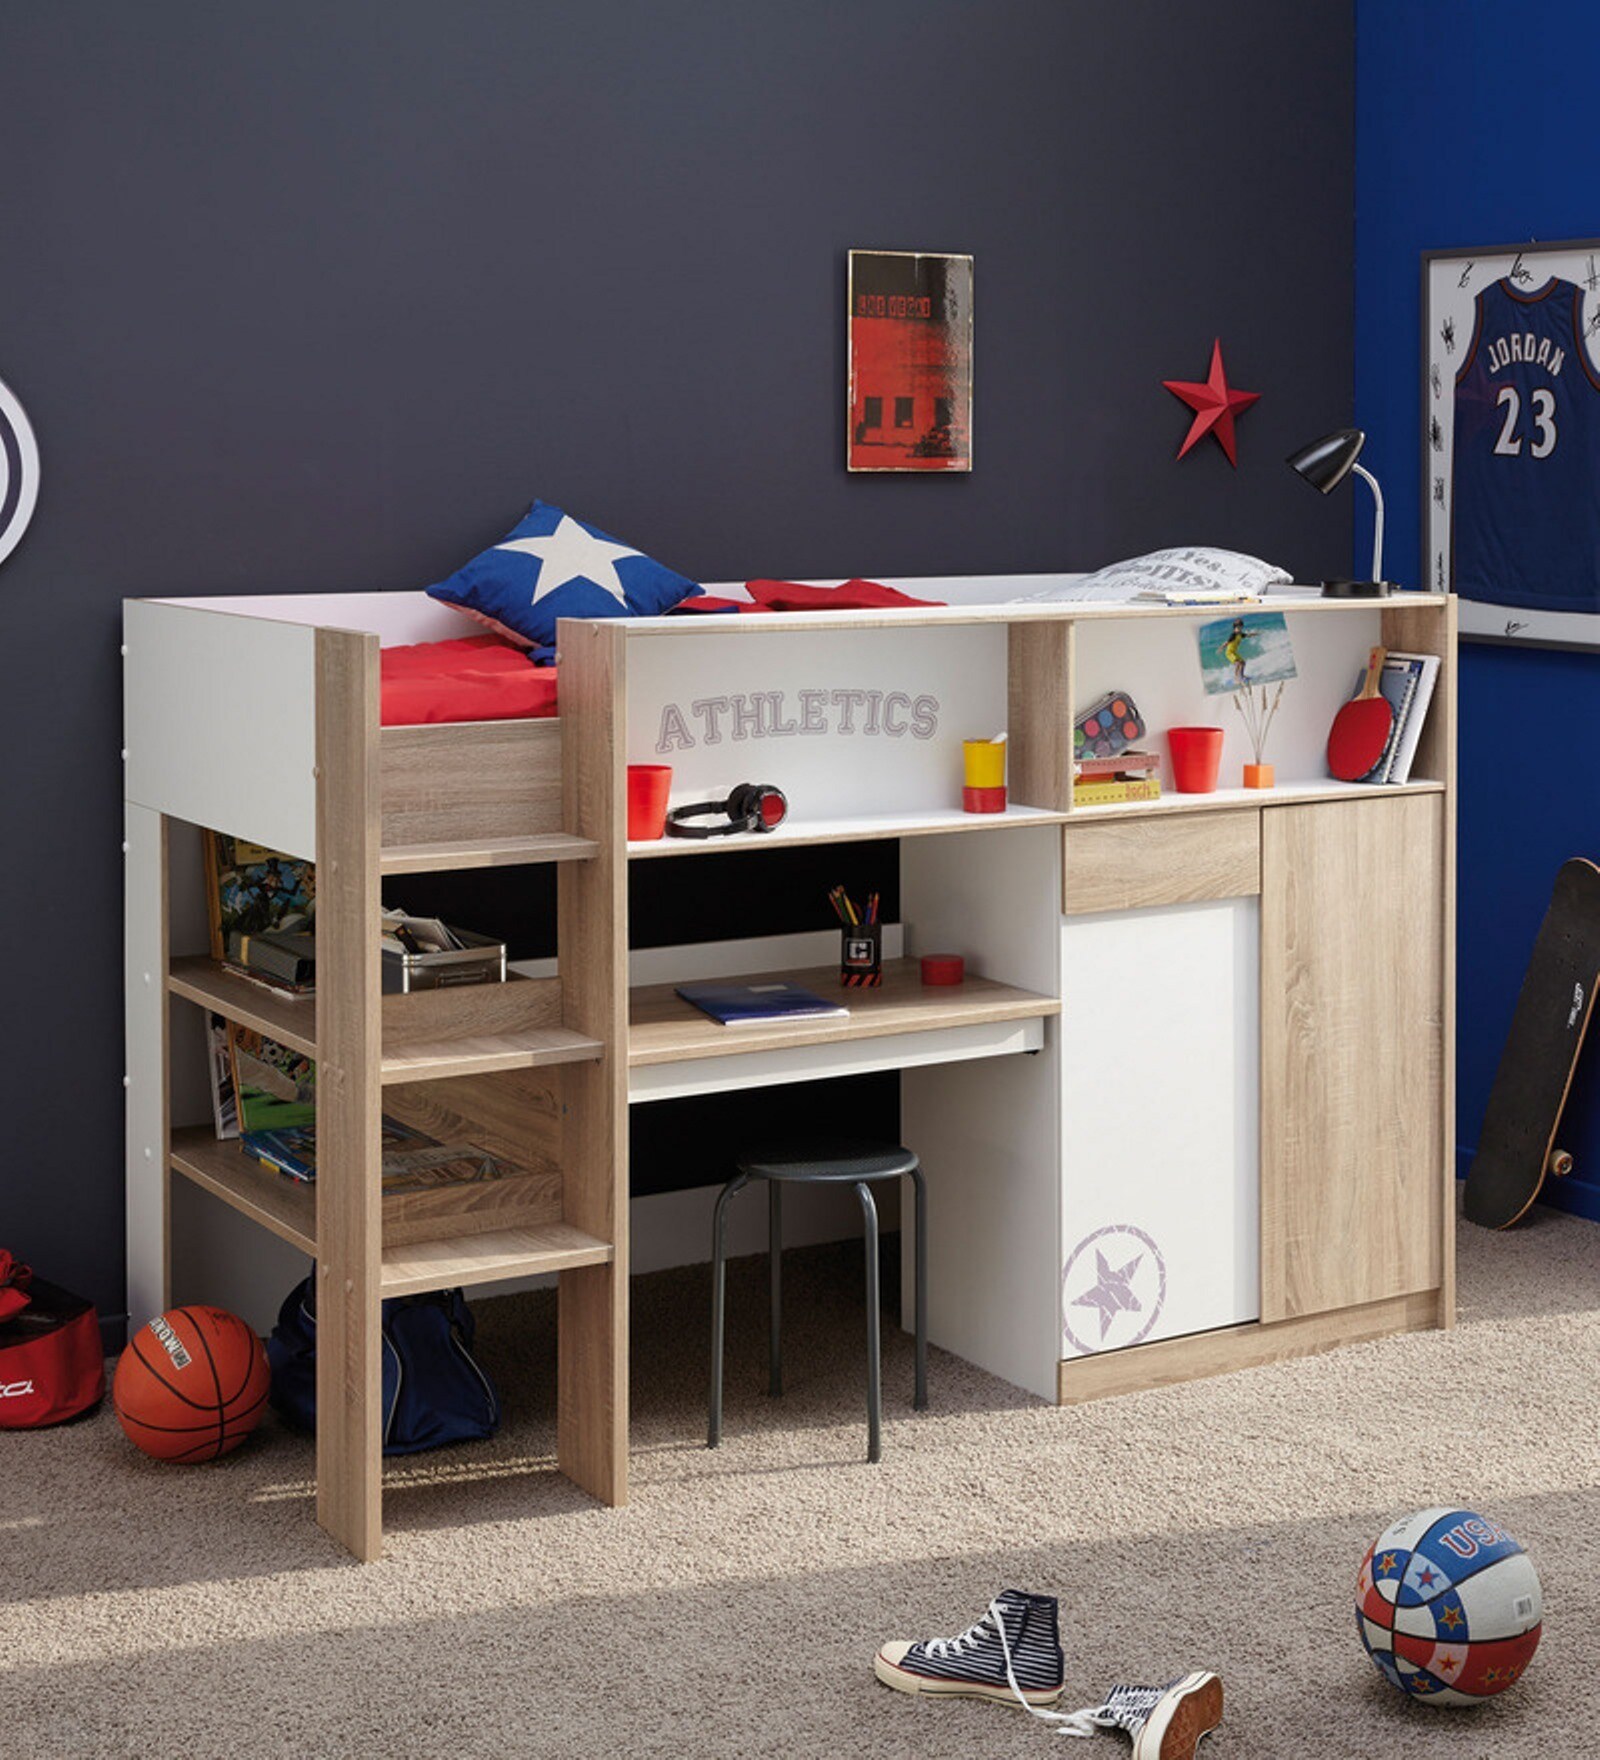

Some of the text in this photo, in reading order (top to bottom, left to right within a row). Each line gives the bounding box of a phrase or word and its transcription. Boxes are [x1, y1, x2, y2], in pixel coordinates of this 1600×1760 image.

[1488, 333, 1565, 376] JORDAN
[1493, 386, 1557, 459] 23
[655, 688, 940, 753] ATHLETICS
